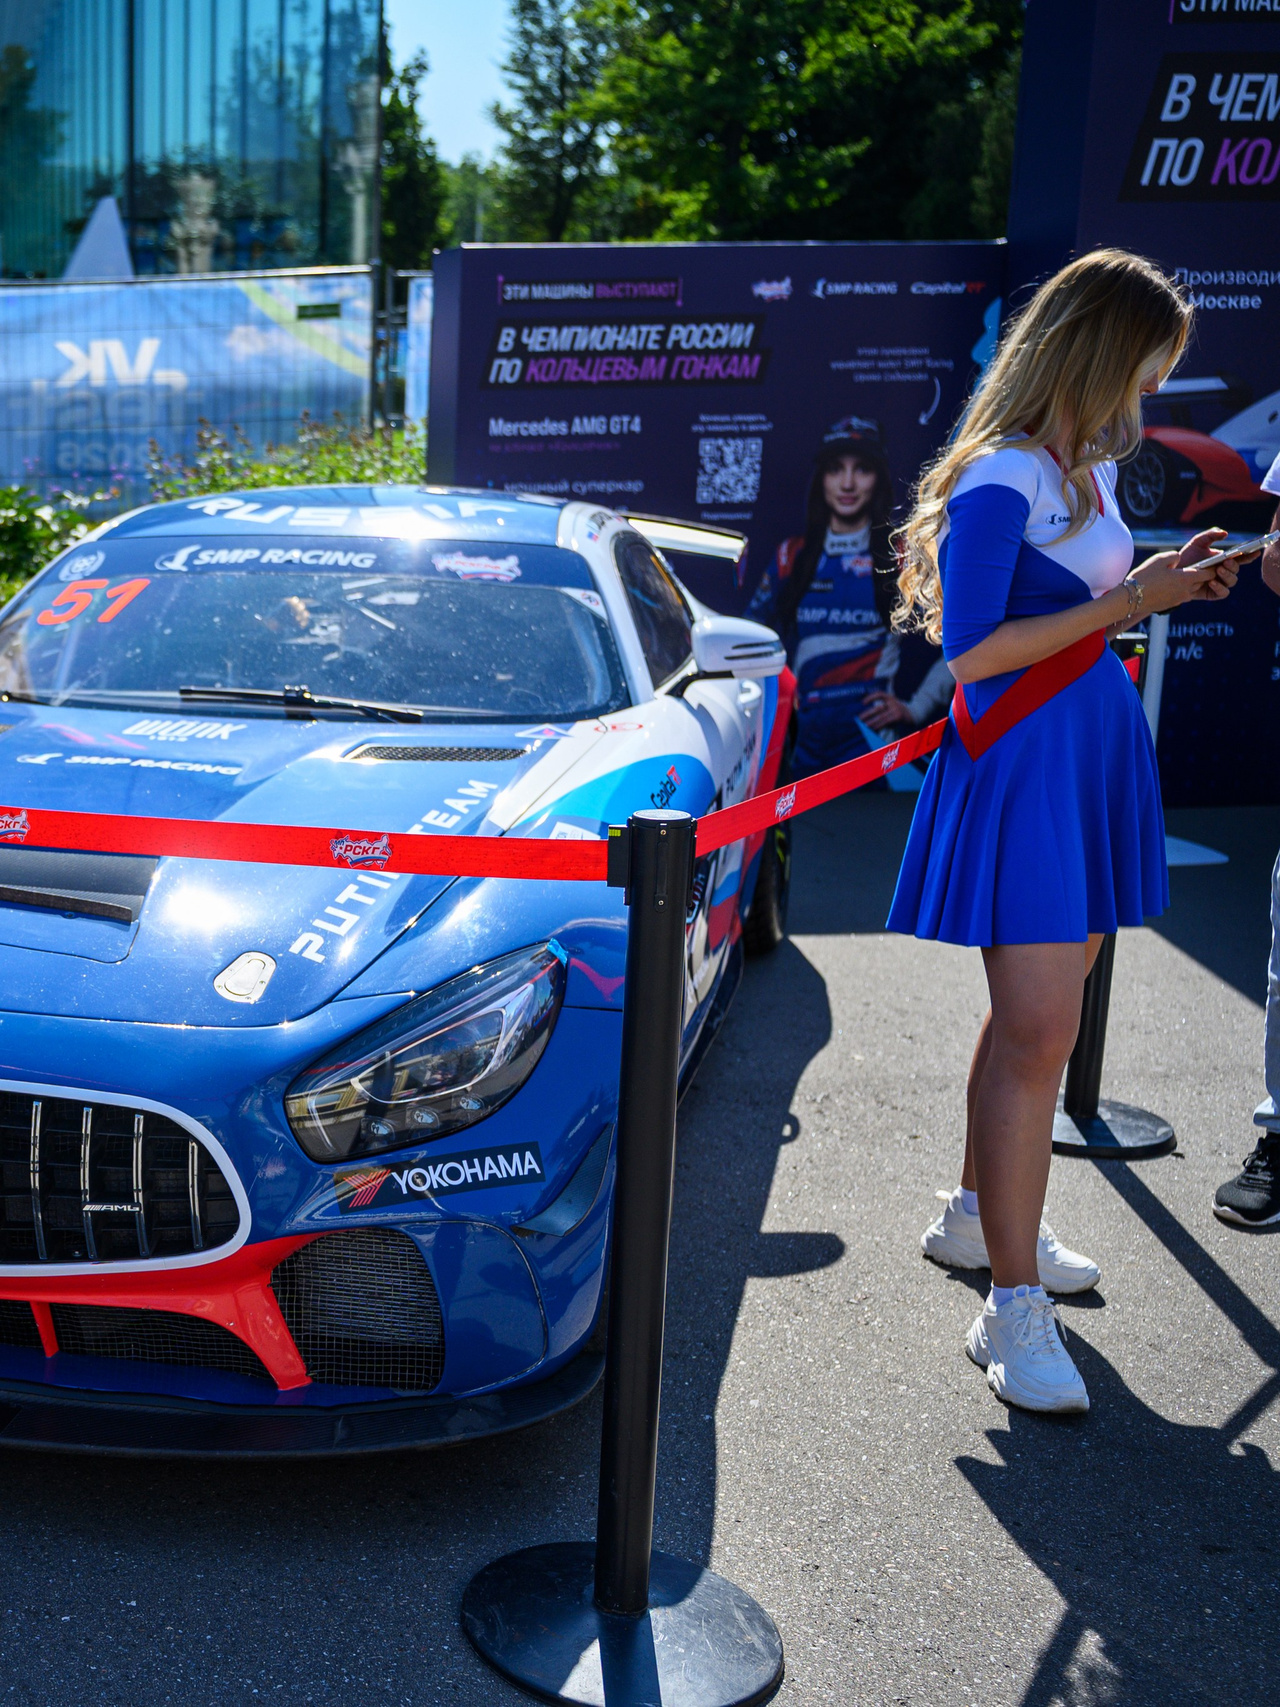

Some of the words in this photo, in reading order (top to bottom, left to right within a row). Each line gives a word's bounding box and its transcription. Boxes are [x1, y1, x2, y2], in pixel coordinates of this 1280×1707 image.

[1160, 73, 1197, 121] В
[1140, 137, 1205, 187] ПО
[531, 283, 595, 299] МАШИНЫ
[498, 326, 516, 352] В
[521, 323, 666, 352] ЧЕМПИОНАТЕ
[666, 322, 755, 350] РОССИИ
[489, 357, 523, 384] ПО
[524, 355, 668, 384] КОЛЬЦЕВЫМ
[670, 353, 762, 379] ГОНКАМ
[489, 417, 568, 437] Mercedes
[571, 416, 607, 435] AMG
[610, 415, 641, 434] GT4
[193, 548, 261, 566] SMP
[260, 549, 377, 570] RACING
[37, 578, 151, 626] 51
[828, 608, 883, 626] RACIN
[65, 755, 132, 766] SMP
[130, 758, 244, 776] RACING
[343, 844, 380, 856] РСКГ
[288, 871, 400, 964] PUTI
[391, 1150, 542, 1195] YOKOHAMA
